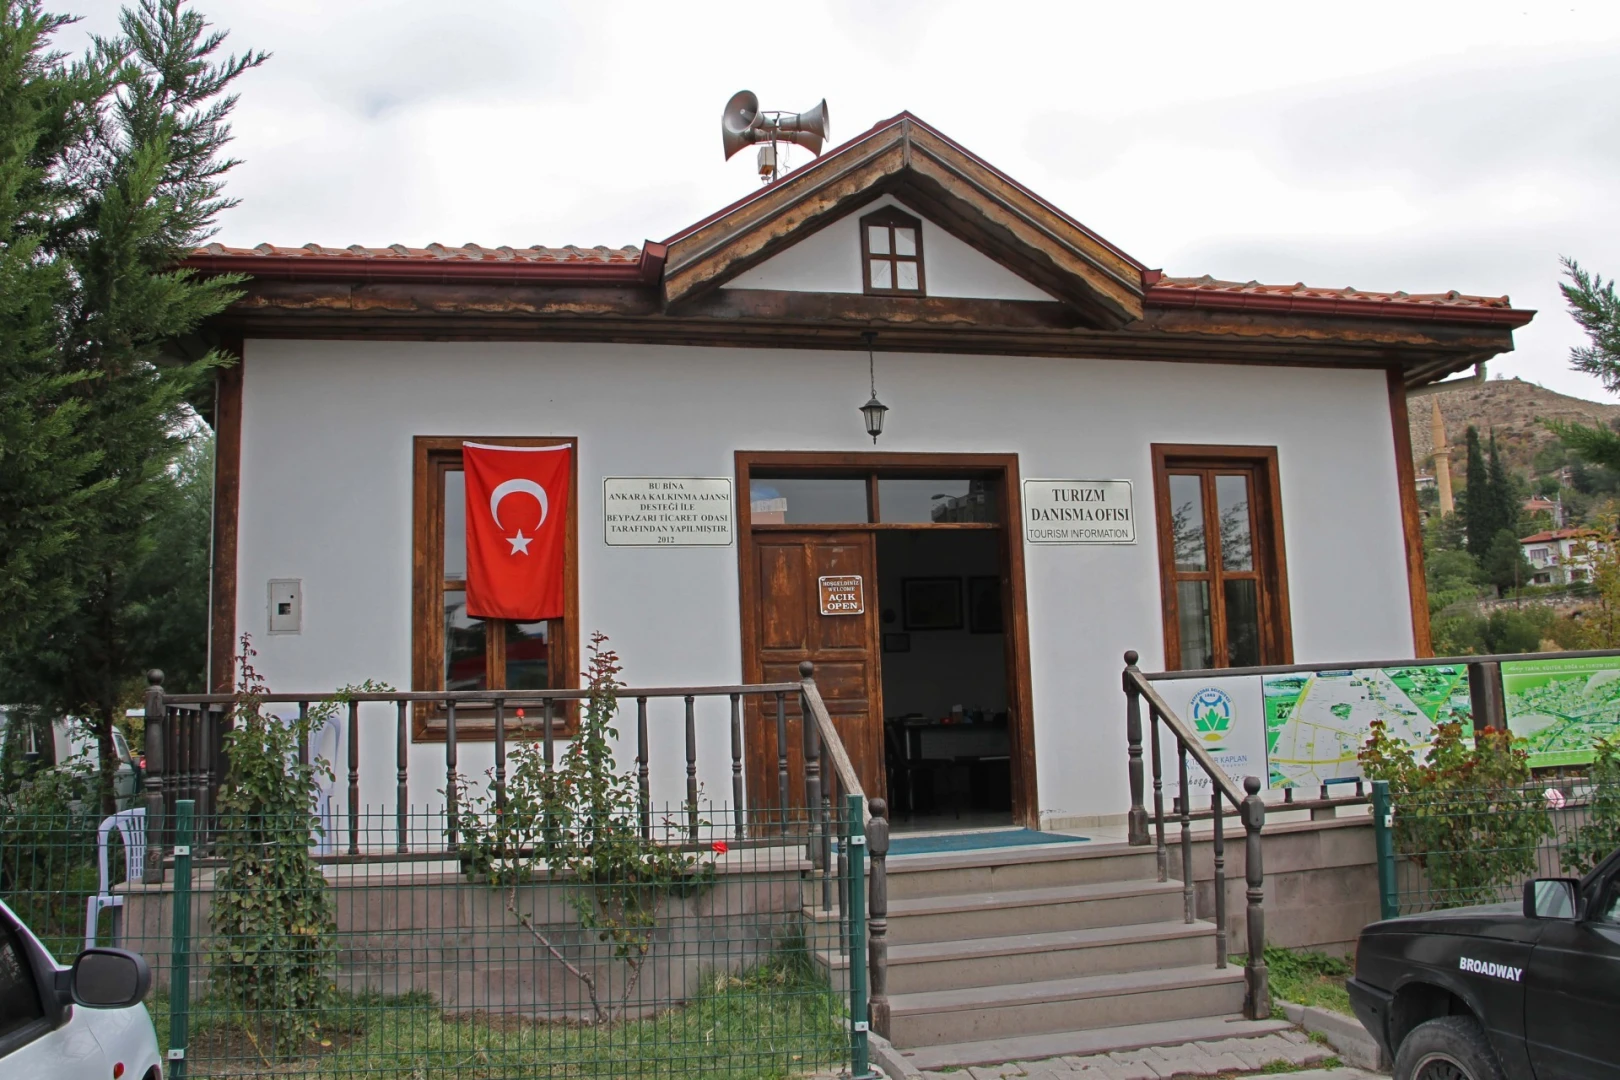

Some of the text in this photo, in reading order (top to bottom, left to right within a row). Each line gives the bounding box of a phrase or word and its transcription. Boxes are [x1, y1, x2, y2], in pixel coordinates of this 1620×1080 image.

[649, 481, 684, 490] BU BİNA
[609, 493, 729, 501] ANKARA KALKINMA AJANSI
[1052, 489, 1106, 502] TURIZM
[640, 503, 695, 511] DESTEĞİ İLE
[606, 514, 728, 522] BEYPAZARI TİCARET ODASI
[1031, 508, 1129, 521] DANISMA OFISI
[611, 525, 729, 534] TARAFINDAN YAPILMIŞTIR.
[1029, 529, 1128, 538] TOURISM INFORMATION
[657, 536, 675, 544] 2012
[829, 594, 856, 602] AÇIK
[1220, 755, 1248, 763] KAPLAN
[1459, 956, 1523, 982] BROADWAY
